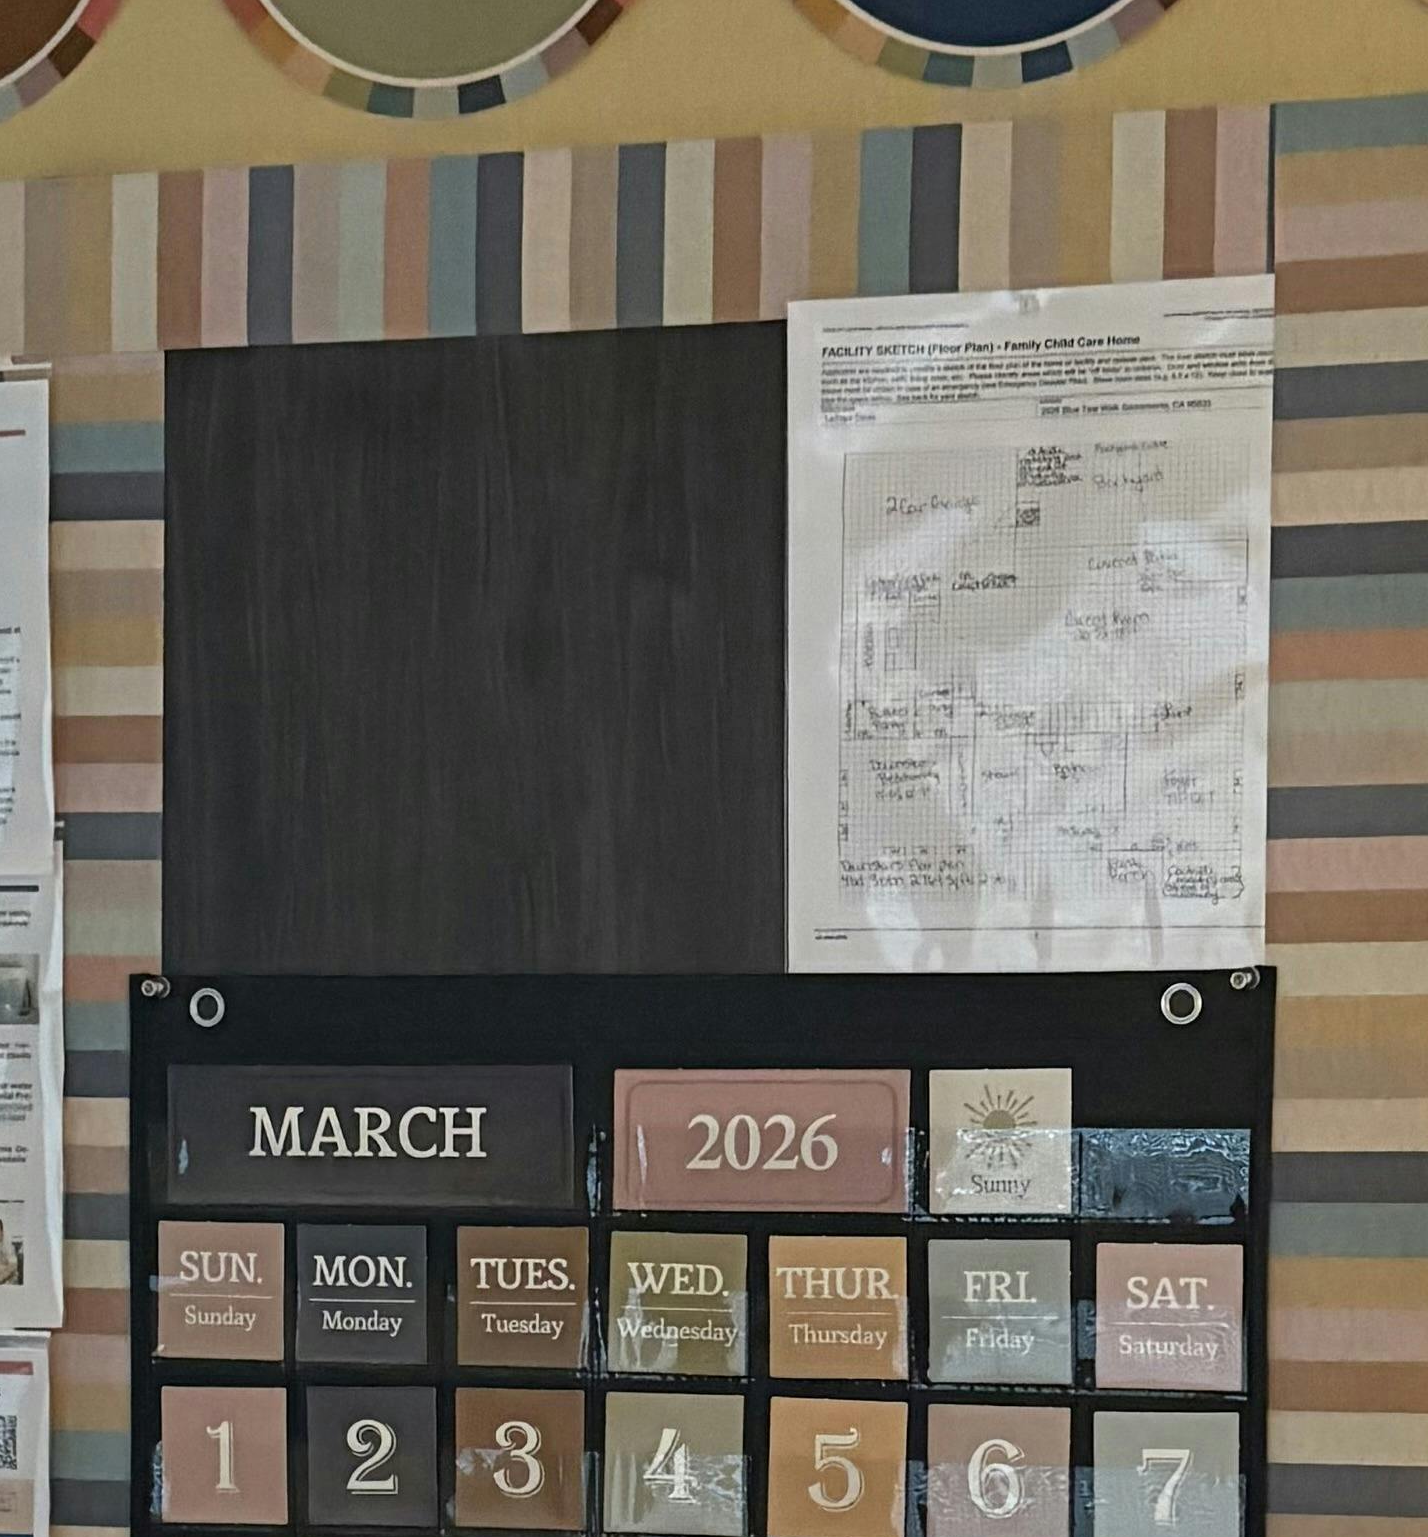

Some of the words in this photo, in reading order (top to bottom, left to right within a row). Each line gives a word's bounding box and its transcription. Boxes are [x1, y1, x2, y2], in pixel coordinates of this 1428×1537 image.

[822, 347, 872, 358] FACILITY
[877, 345, 924, 356] SKETCH
[927, 343, 961, 356] (Floor
[1005, 341, 1041, 352] Family
[1044, 338, 1074, 349] Child
[1077, 337, 1104, 347] Care
[250, 1105, 488, 1158] MARCH
[686, 1113, 839, 1172] 2026
[970, 1172, 1033, 1200] Sunny
[179, 1250, 263, 1284] SUN.
[313, 1257, 414, 1289] MON.
[471, 1258, 576, 1294] TUES.
[627, 1261, 730, 1299] WED.
[1127, 1277, 1214, 1311] SAT.
[183, 1305, 257, 1330] Sunday
[322, 1311, 404, 1335] Monday
[482, 1313, 564, 1339] Tuesday
[618, 1319, 738, 1345] Wednesday
[789, 1323, 887, 1349] Thursday
[967, 1326, 1035, 1353] Friday
[1119, 1335, 1220, 1362] Saturday
[206, 1420, 237, 1493] 1
[347, 1420, 398, 1495] 2
[494, 1421, 543, 1498] 3
[644, 1429, 694, 1502] 4
[808, 1427, 864, 1510] 5
[967, 1440, 1024, 1518] 6
[1138, 1448, 1192, 1525] 7
